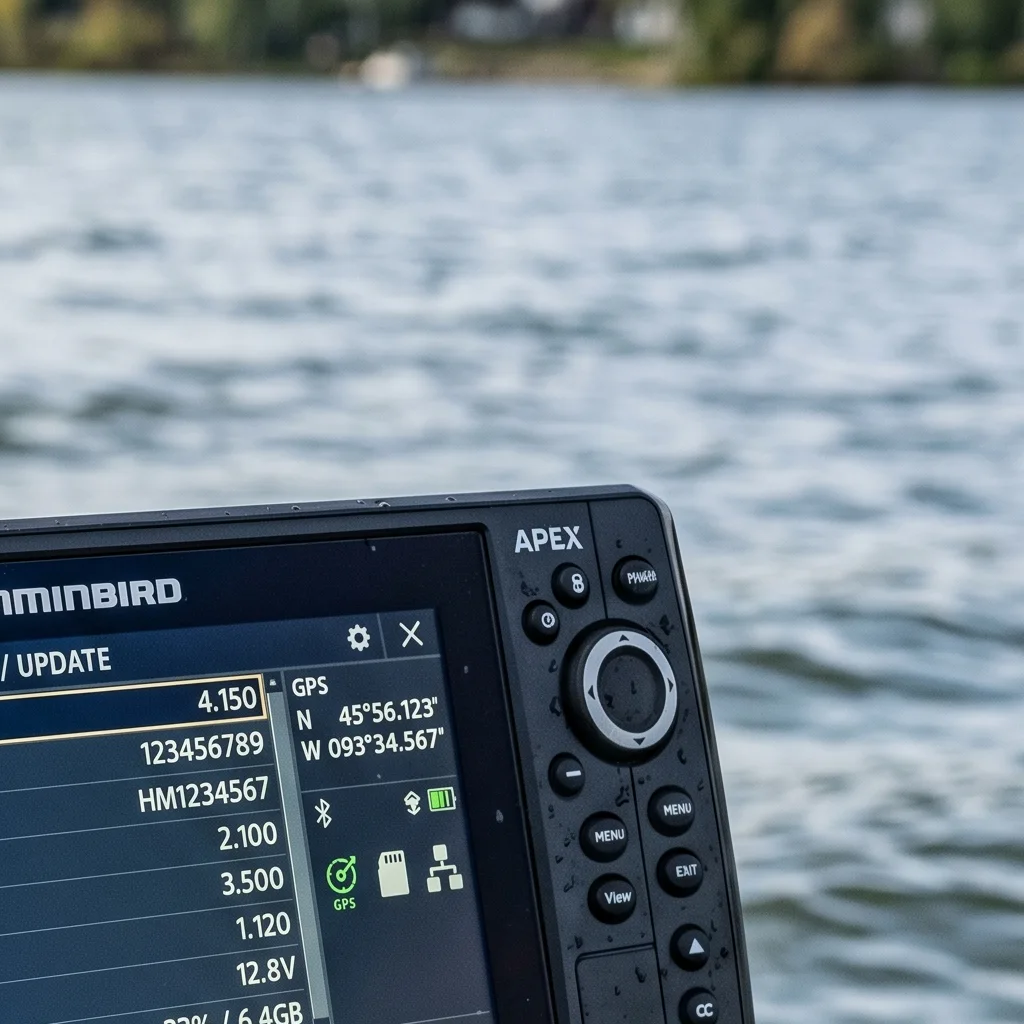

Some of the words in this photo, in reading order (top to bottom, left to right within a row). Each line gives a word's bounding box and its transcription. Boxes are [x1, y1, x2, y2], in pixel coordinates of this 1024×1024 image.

[515, 526, 583, 553] APEX
[1, 654, 8, 681] /
[17, 647, 111, 677] UPDATE
[198, 686, 256, 712] 4.150
[292, 676, 328, 696] GPS
[297, 709, 312, 730] N
[141, 731, 263, 765] 123456789
[301, 740, 320, 760] W
[139, 776, 268, 812] HM1234567
[664, 803, 691, 815] MENU
[218, 822, 277, 850] 2.100
[595, 829, 624, 842] MENU
[221, 867, 283, 895] 3.500
[334, 898, 355, 910] GPS
[236, 912, 290, 939] 1.120
[237, 956, 295, 985] 12.8V
